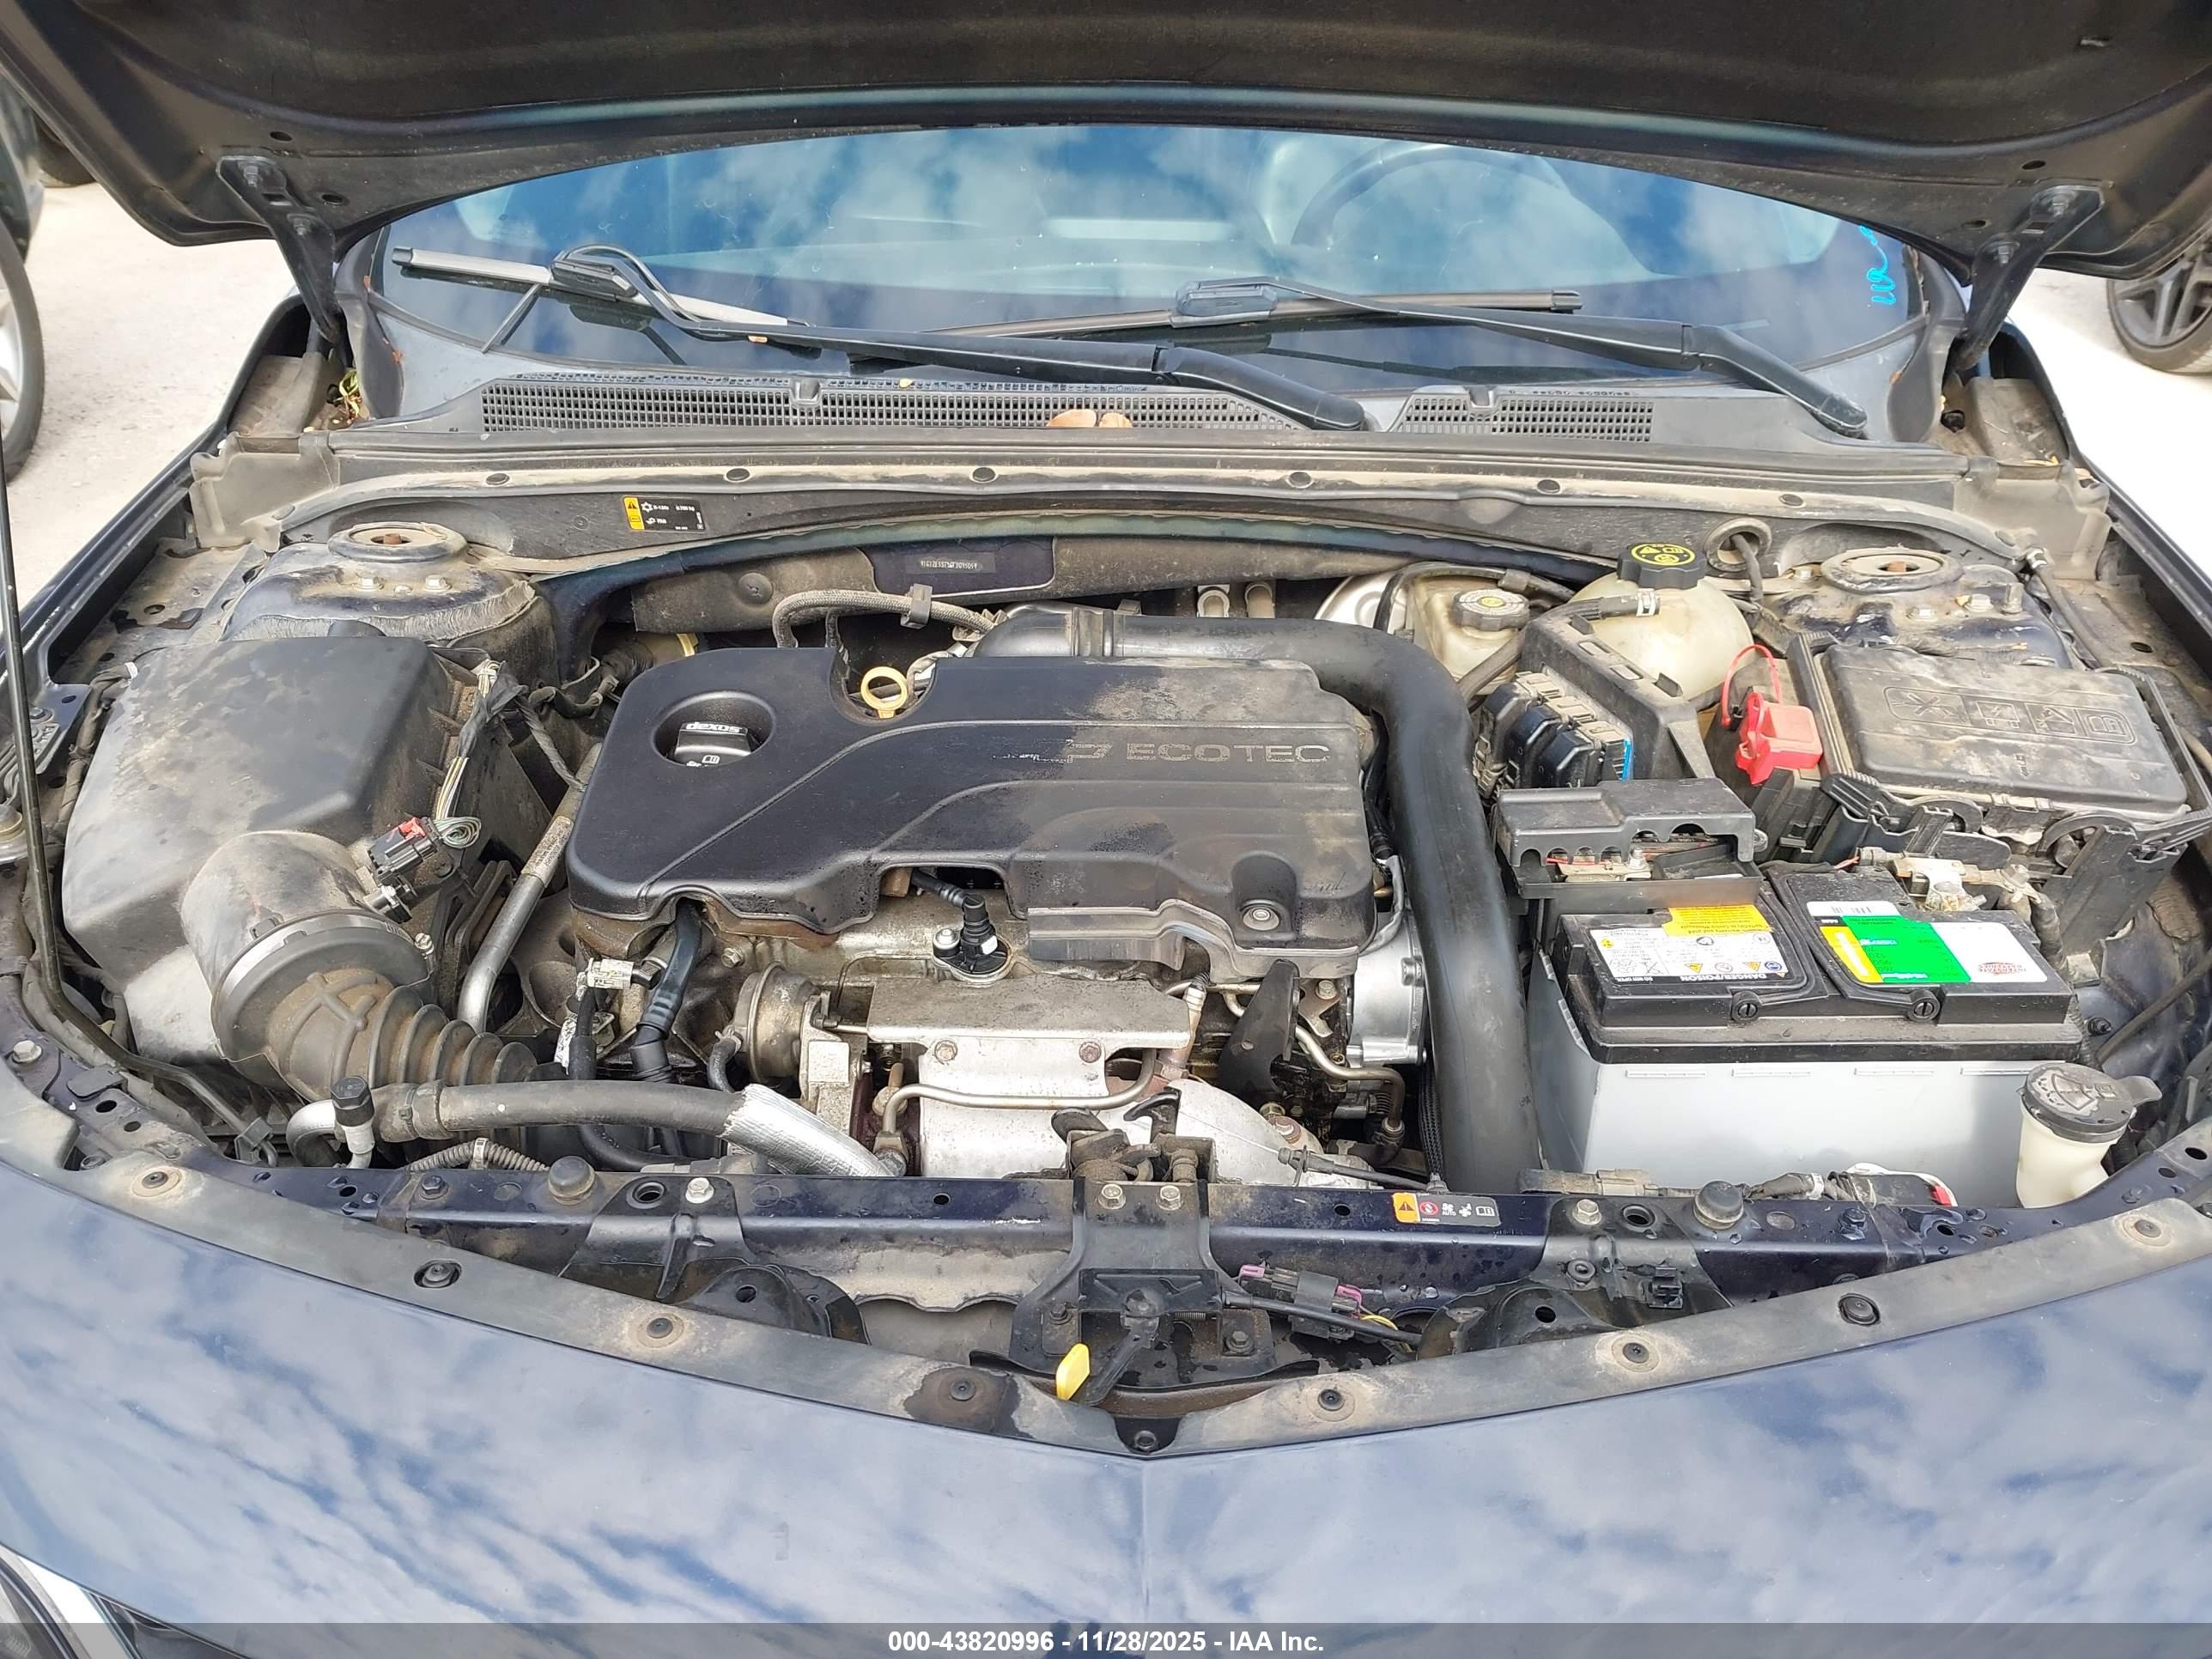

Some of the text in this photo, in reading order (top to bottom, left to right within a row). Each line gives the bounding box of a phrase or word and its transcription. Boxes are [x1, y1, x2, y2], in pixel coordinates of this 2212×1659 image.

[686, 721, 740, 732] dexos
[1127, 742, 1330, 763] ECOTEC
[1680, 973, 1767, 981] DANGER/POISON
